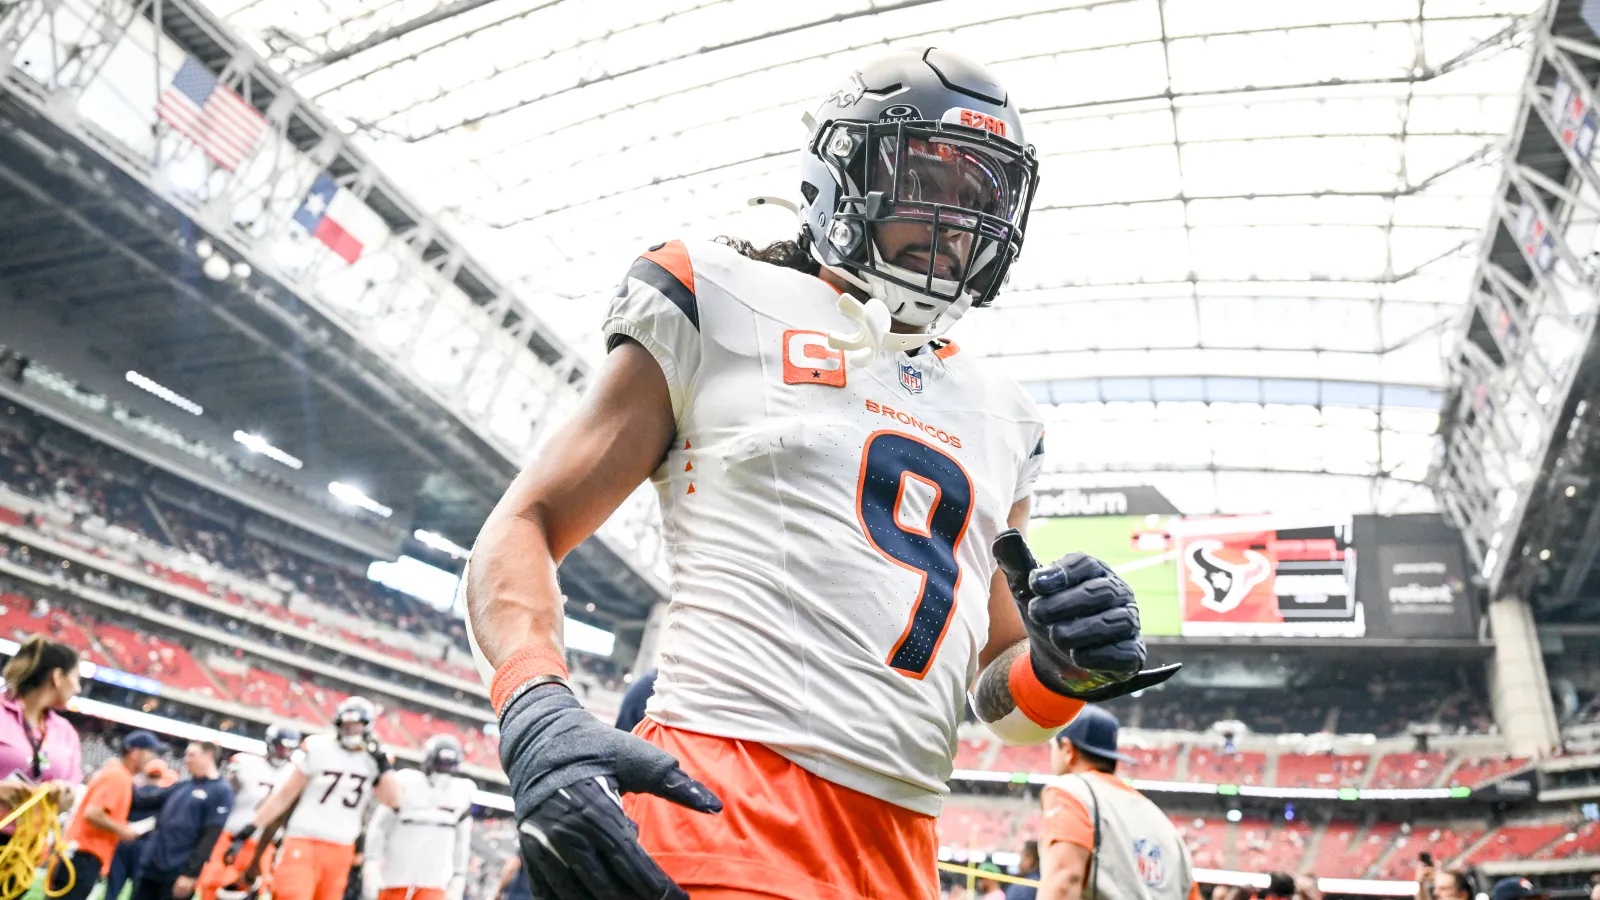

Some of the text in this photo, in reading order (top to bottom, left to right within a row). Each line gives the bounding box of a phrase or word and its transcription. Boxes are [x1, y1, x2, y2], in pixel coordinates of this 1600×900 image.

[879, 116, 919, 124] OAKLEY
[960, 109, 1006, 138] 5280
[788, 333, 841, 371] C
[903, 373, 922, 391] NFL
[865, 399, 963, 449] BRONCOS
[856, 430, 975, 680] 9
[319, 770, 367, 808] 73
